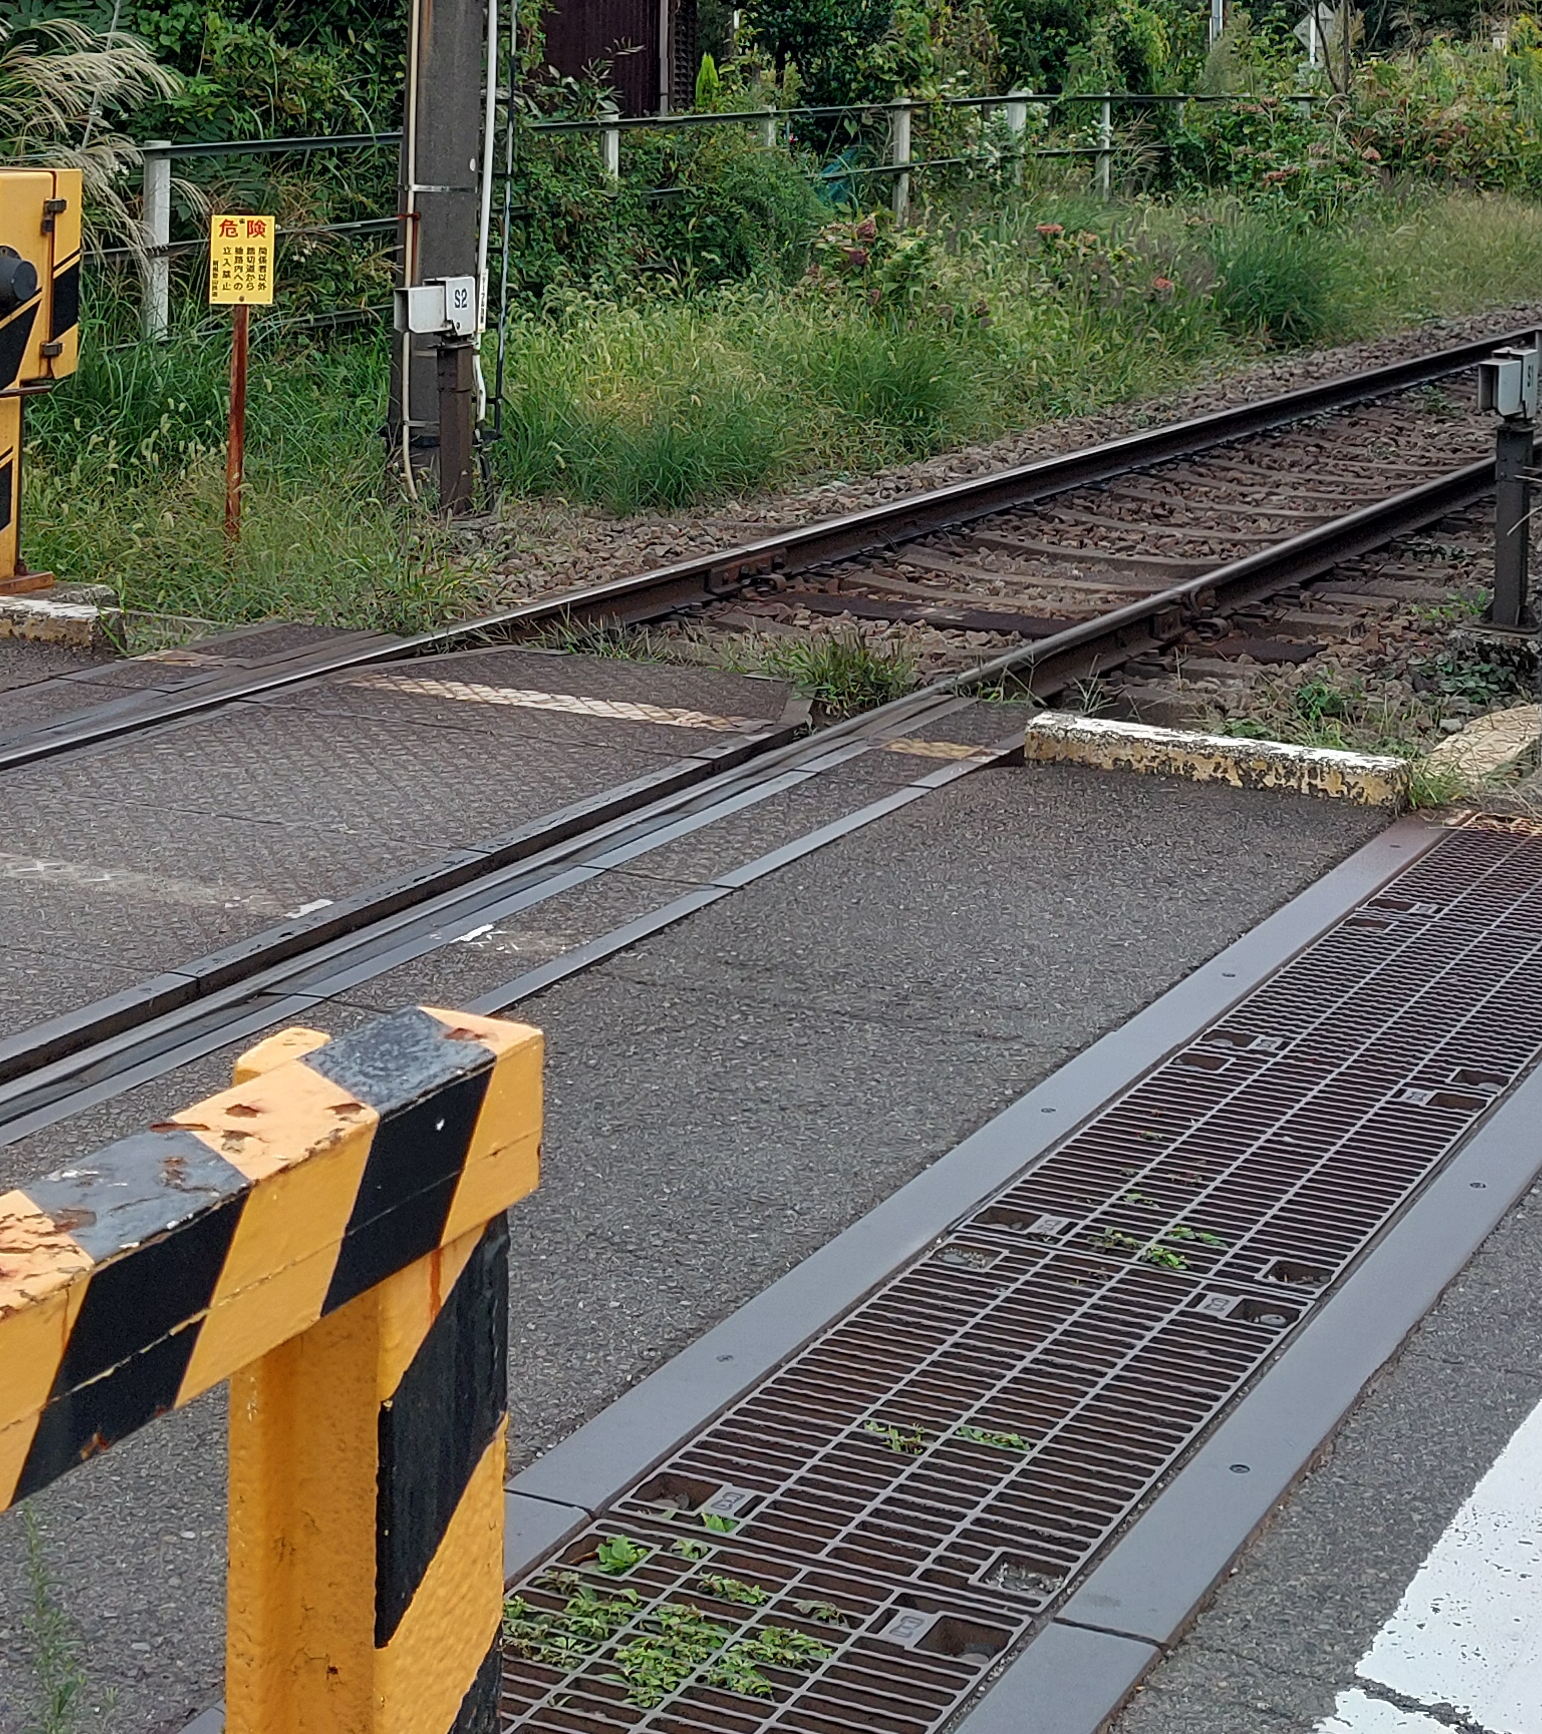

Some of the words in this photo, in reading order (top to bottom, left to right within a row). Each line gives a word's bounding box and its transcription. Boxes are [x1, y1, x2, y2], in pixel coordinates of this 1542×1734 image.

[219, 219, 267, 239] 危険
[222, 246, 232, 291] 立入禁止
[233, 247, 244, 290] 線路内への
[246, 247, 256, 291] 踏切道から
[258, 247, 268, 291] 関係者以外
[454, 287, 468, 309] S2
